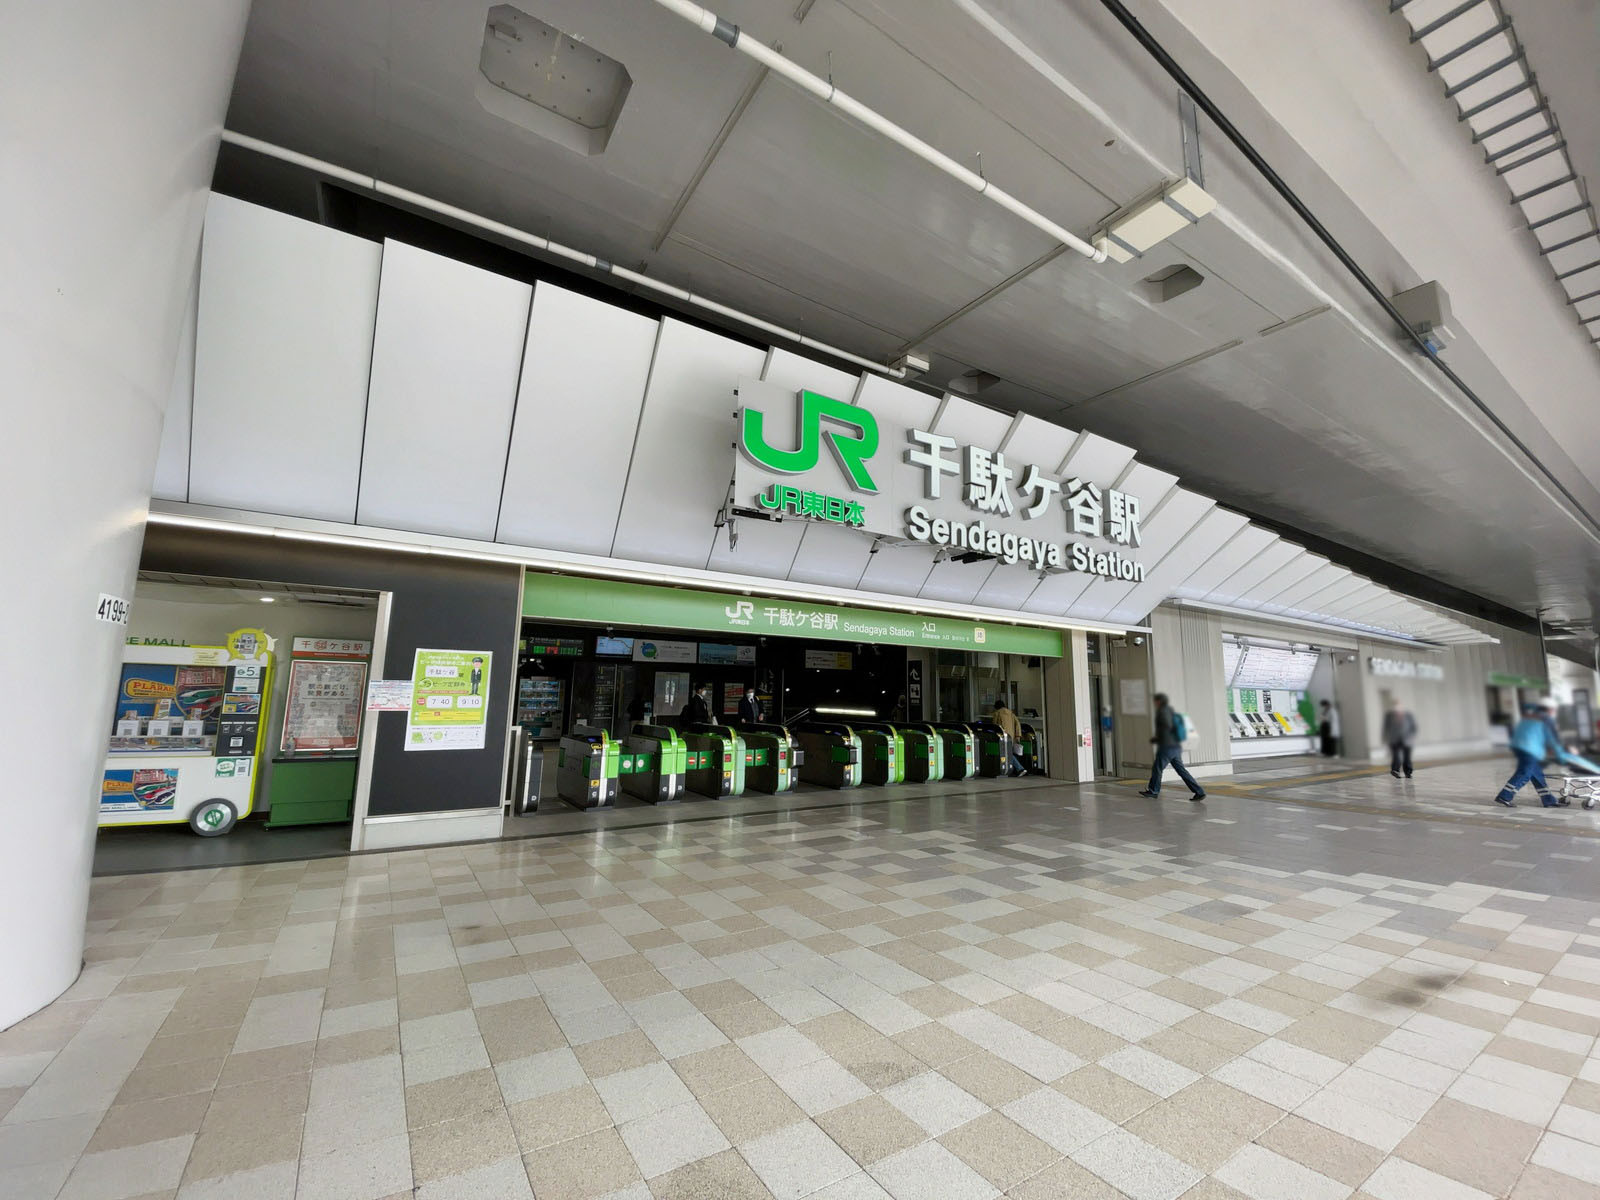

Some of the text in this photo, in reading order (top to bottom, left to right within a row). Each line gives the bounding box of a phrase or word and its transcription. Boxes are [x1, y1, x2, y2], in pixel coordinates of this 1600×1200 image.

[740, 389, 879, 492] JR
[905, 428, 1143, 547] 千駄ケ谷駅
[757, 484, 865, 527] JR東日本
[906, 504, 1145, 583] Sendagaya Station
[725, 601, 754, 620] JR
[144, 637, 191, 648] MALL
[843, 622, 915, 638] Sendagaya Station
[922, 622, 936, 632] 入口
